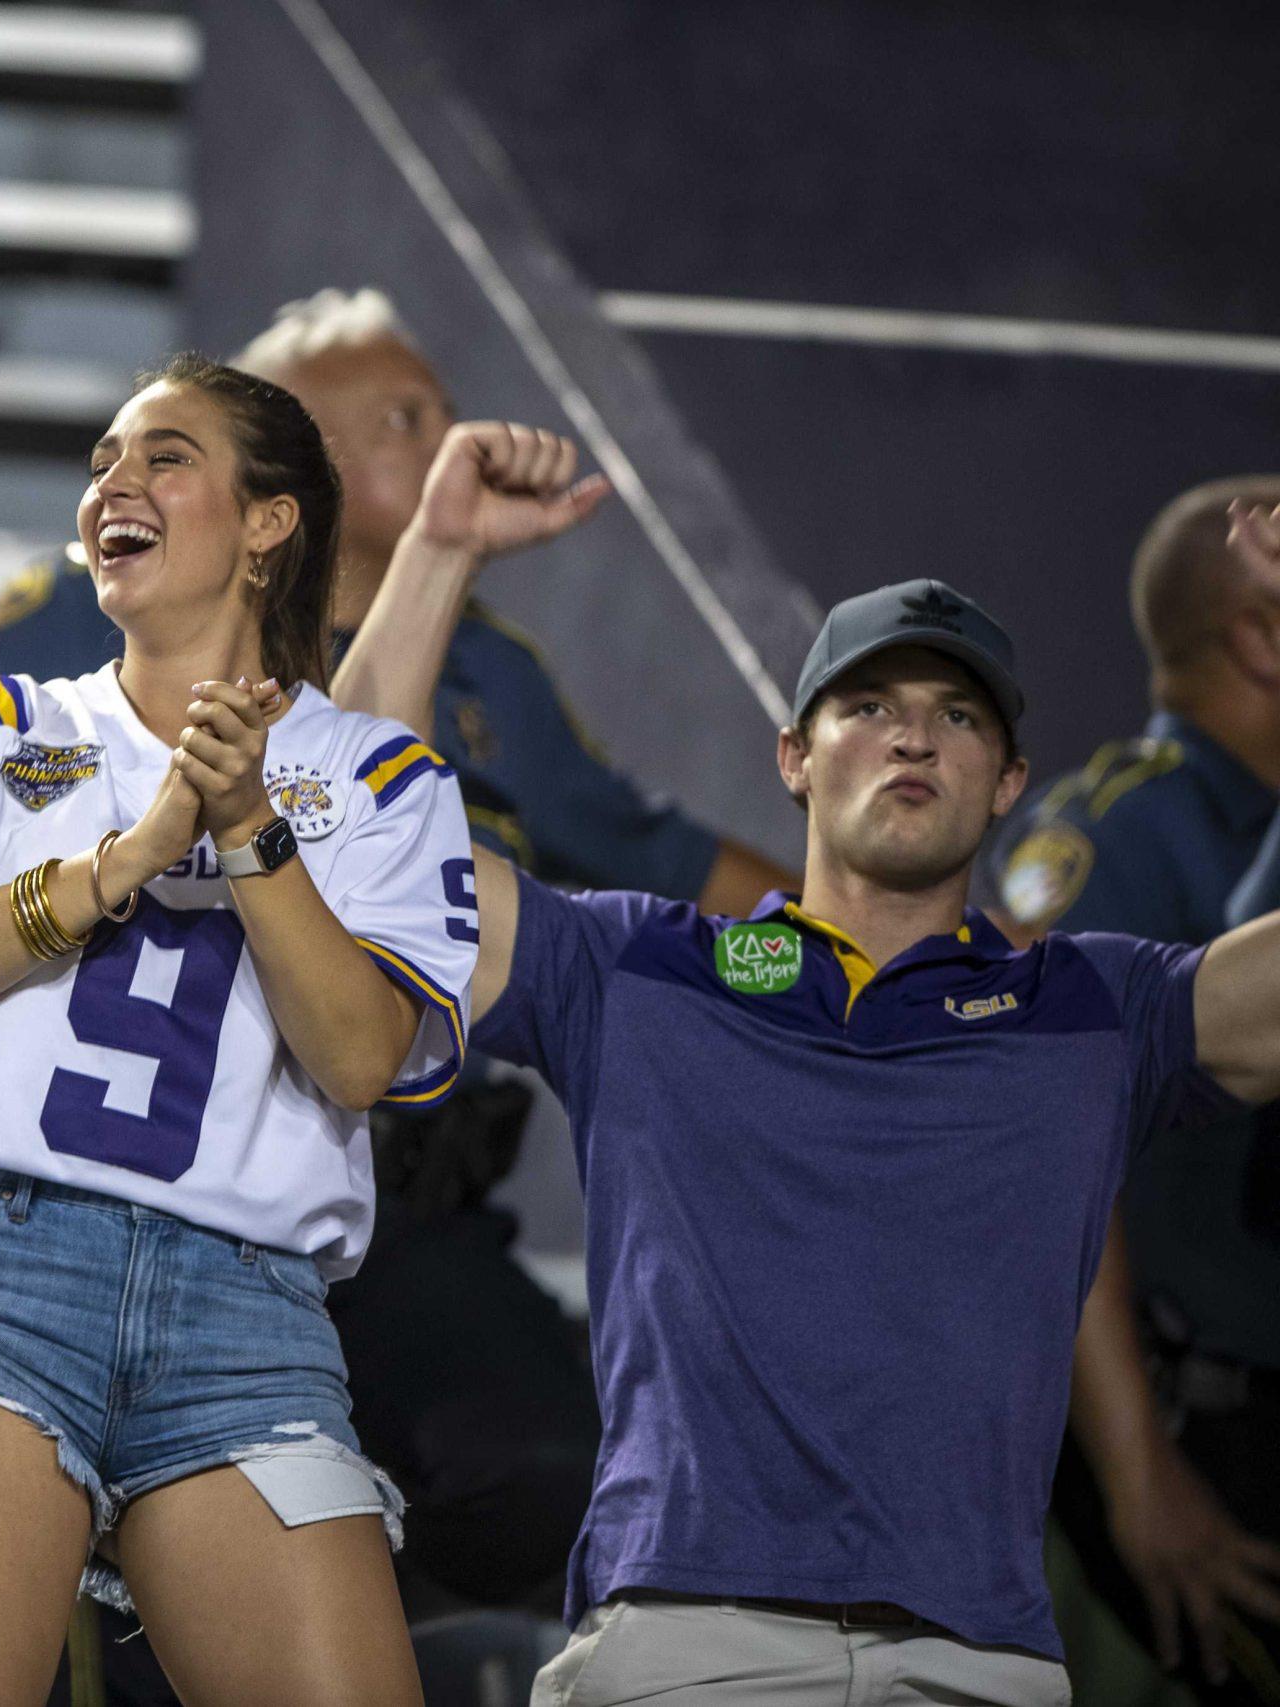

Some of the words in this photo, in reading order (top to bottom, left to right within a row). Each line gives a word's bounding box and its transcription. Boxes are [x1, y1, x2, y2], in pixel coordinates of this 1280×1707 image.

[3, 761, 96, 783] CHAMPIONS
[296, 817, 333, 833] LTA
[723, 965, 752, 985] the
[944, 992, 1018, 1021] LSU
[40, 888, 246, 1182] 9
